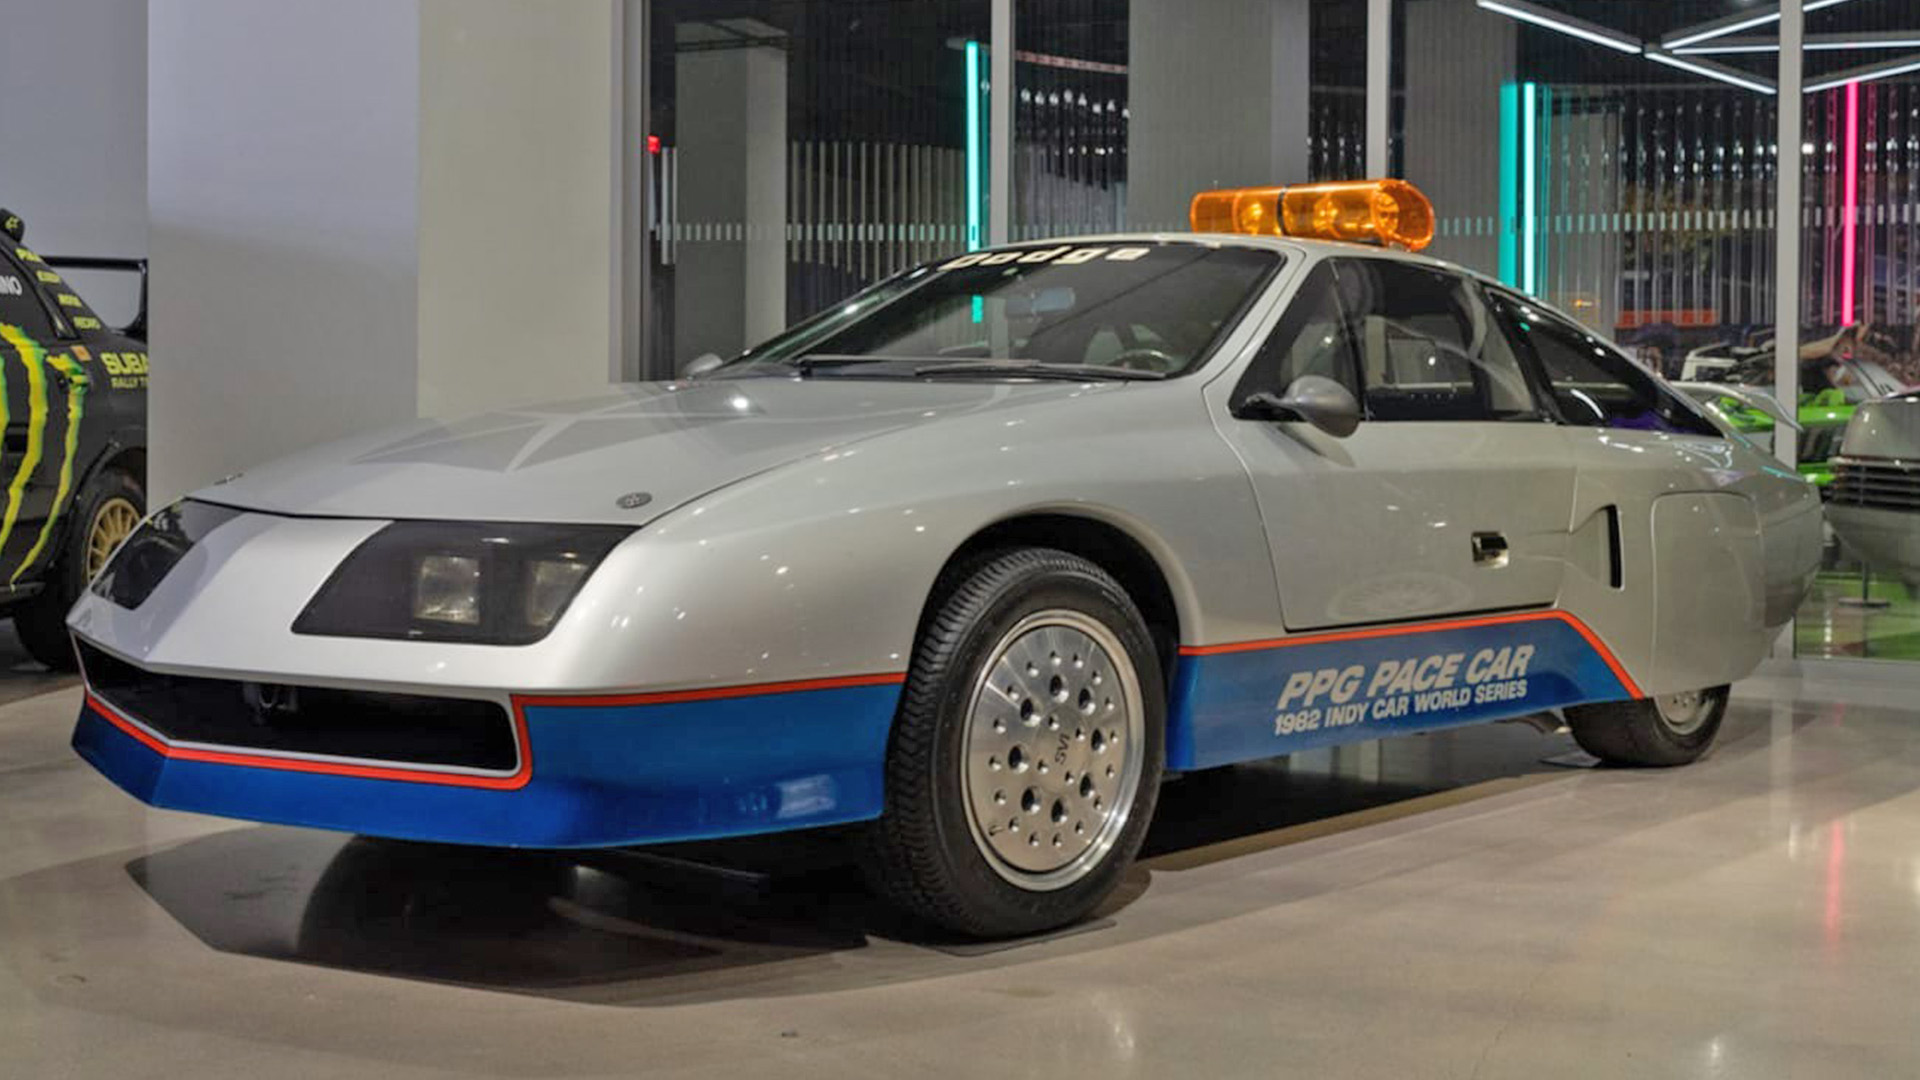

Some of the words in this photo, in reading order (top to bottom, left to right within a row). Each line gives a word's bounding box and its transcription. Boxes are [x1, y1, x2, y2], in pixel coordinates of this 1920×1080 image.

[936, 245, 1151, 272] Dodge
[1276, 665, 1365, 710] PPG
[1366, 653, 1464, 697] PACE
[1465, 644, 1535, 685] CAR
[1274, 710, 1321, 736] 1982
[1324, 703, 1369, 728] INDY
[1372, 696, 1409, 720] CAR
[1414, 689, 1471, 713] WORLD
[1474, 679, 1527, 705] SERIES
